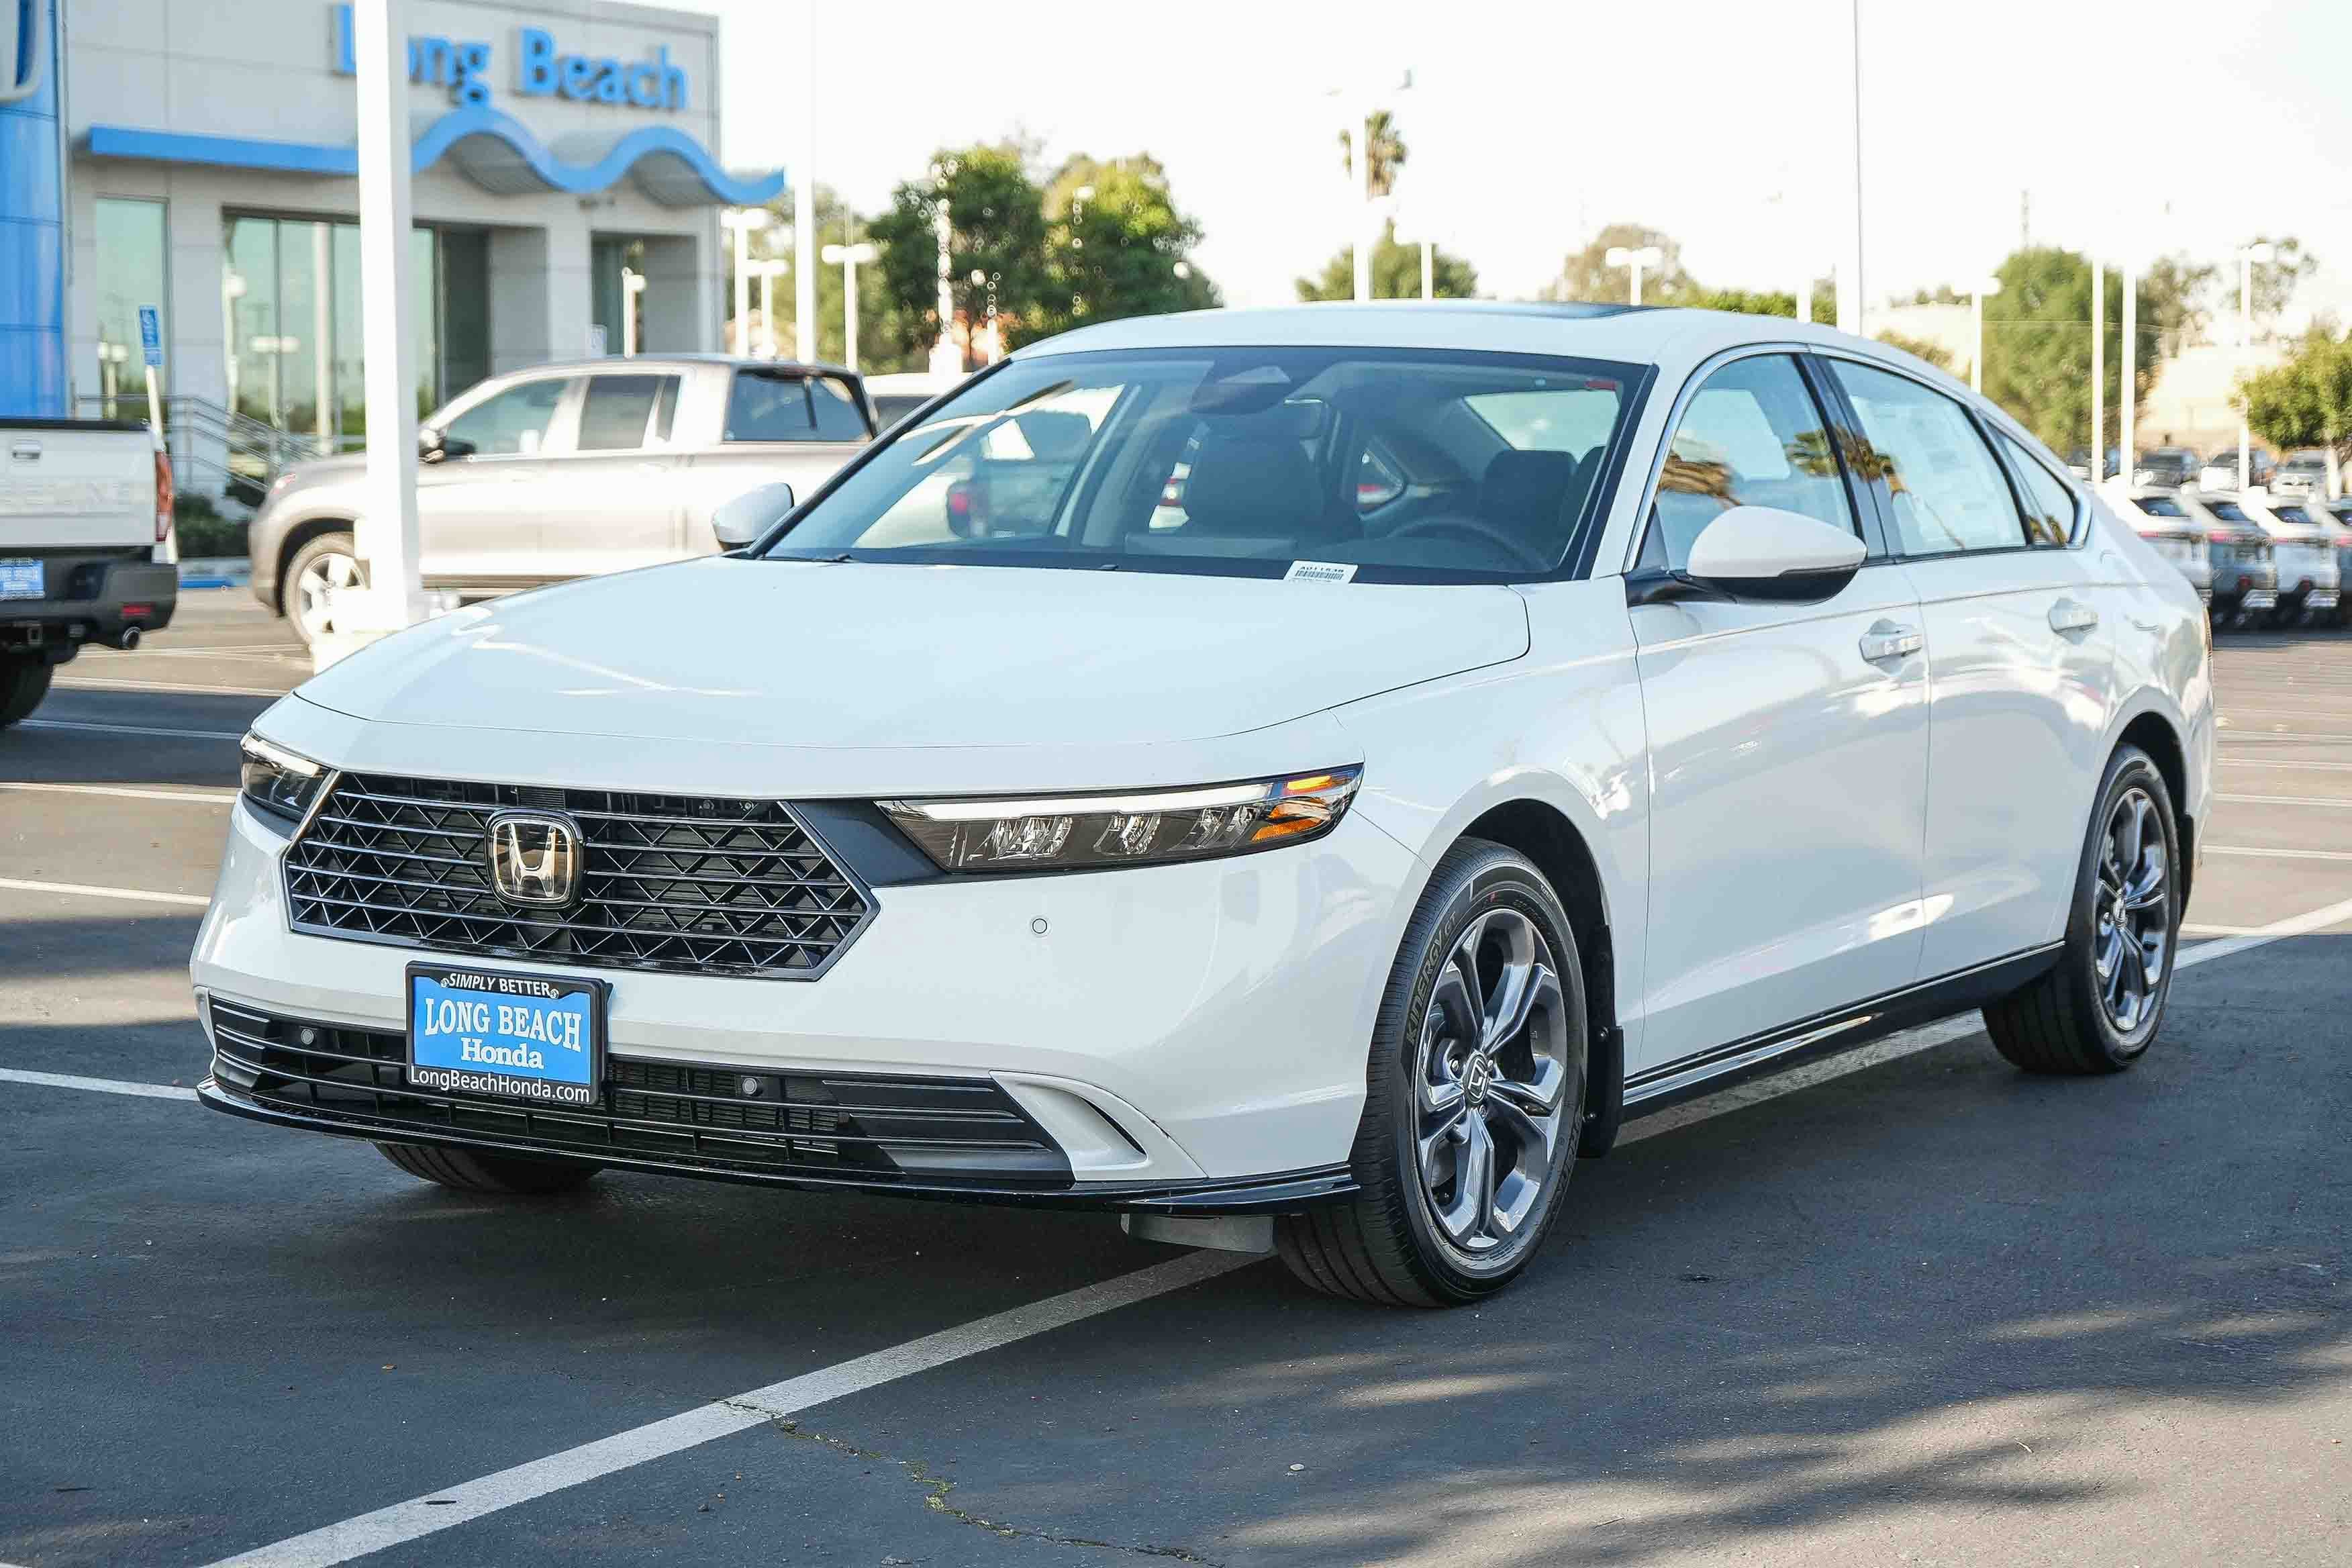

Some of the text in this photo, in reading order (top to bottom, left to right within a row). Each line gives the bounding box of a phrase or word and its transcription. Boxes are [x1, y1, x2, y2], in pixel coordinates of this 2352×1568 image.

[336, 3, 687, 111] Lng Beach
[448, 973, 550, 996] SIMPLY BETTER
[424, 997, 583, 1053] LONG BEACH
[460, 1036, 545, 1069] Honda
[410, 1065, 590, 1103] LongBeachHonda.com
